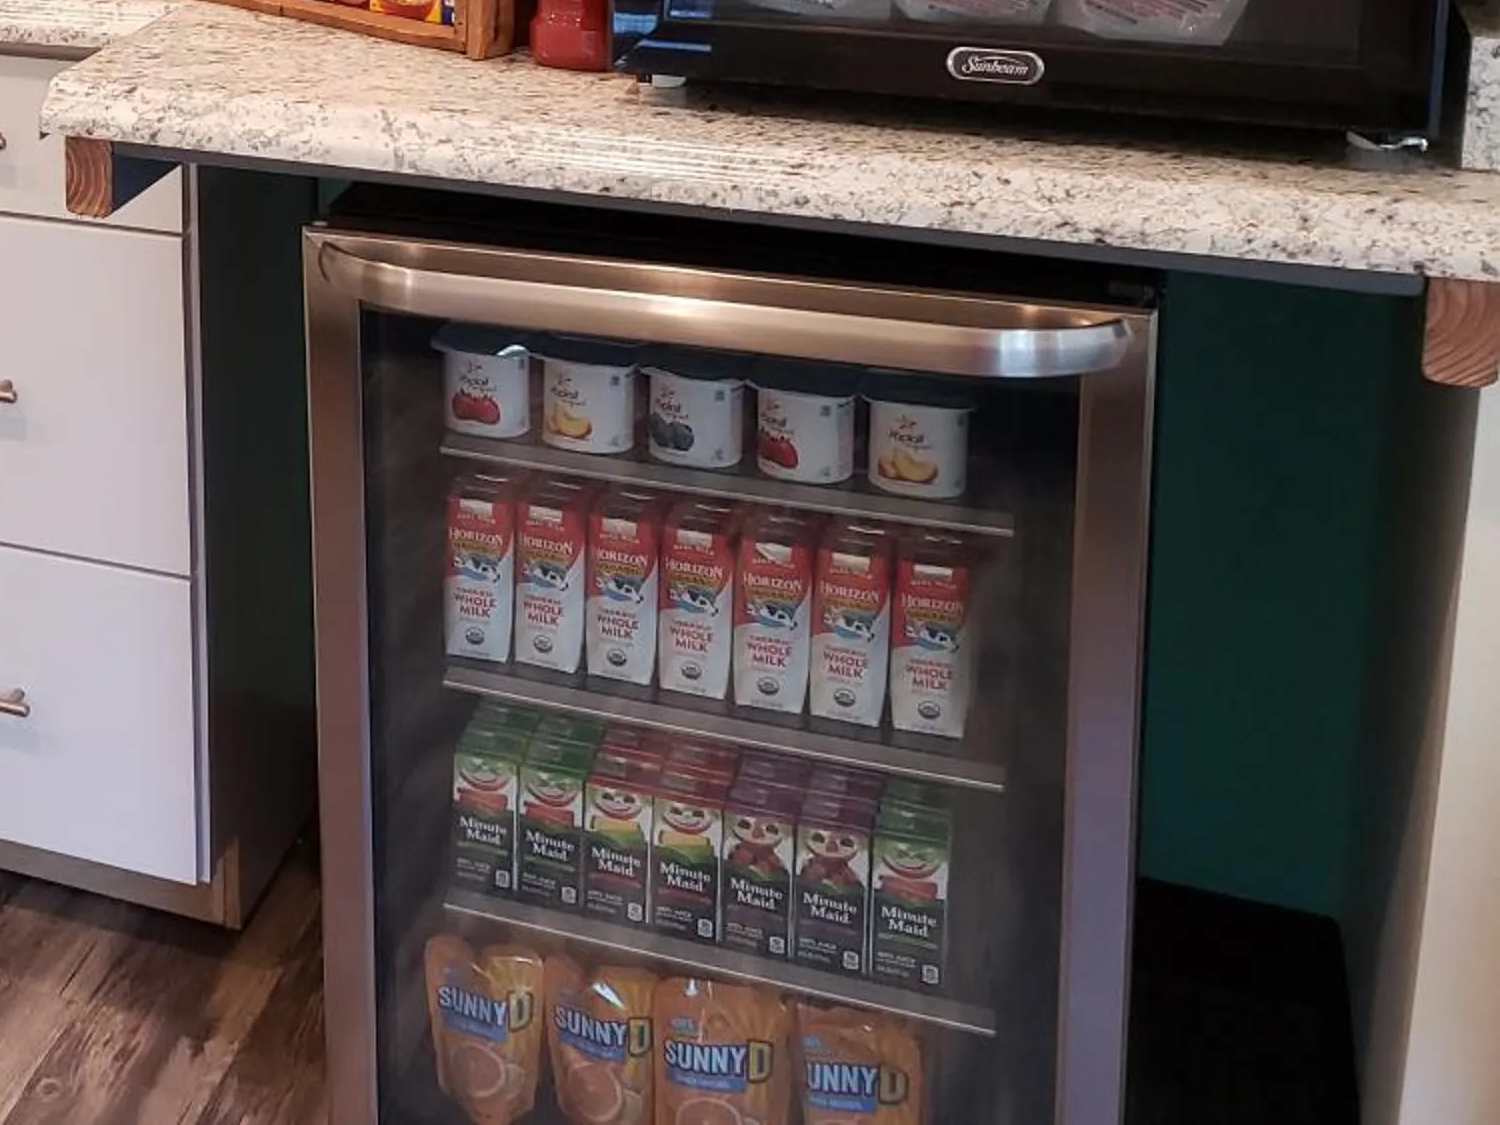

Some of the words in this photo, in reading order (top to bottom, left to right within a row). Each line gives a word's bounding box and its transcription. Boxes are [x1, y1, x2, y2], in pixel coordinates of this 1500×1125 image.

[961, 54, 1029, 75] Sunbeam
[450, 526, 503, 546] HORIZON
[665, 556, 723, 578] HORIZON
[743, 572, 802, 592] HORIZON
[454, 592, 497, 608] WHOLE
[820, 581, 880, 603] HORIZON
[460, 605, 491, 618] MILK
[524, 600, 564, 617] WHOLE
[902, 592, 964, 616] HORIZON
[528, 613, 558, 625] MILK
[598, 616, 639, 630] WHOLE
[602, 626, 633, 640] MILK
[670, 626, 713, 642] WHOLE
[676, 638, 708, 652] MILK
[748, 642, 792, 656] WHOLE
[753, 654, 786, 667] MILK
[823, 650, 869, 668] WHOLE
[828, 664, 863, 679] MILK
[906, 664, 954, 680] WHOLE
[912, 677, 948, 691] MILK
[460, 815, 508, 835] Minute
[467, 829, 501, 845] Maid
[526, 829, 575, 851] Minute
[533, 842, 568, 861] Maid
[591, 846, 641, 868] Minute
[598, 859, 634, 877] Maid
[660, 861, 711, 883] Minute
[667, 874, 703, 892] Maid
[730, 877, 783, 900] Minute
[737, 890, 776, 910] Maid
[803, 892, 857, 915] Minute
[811, 905, 851, 924] Maid
[881, 906, 938, 928] Minute
[888, 918, 928, 937] Maid
